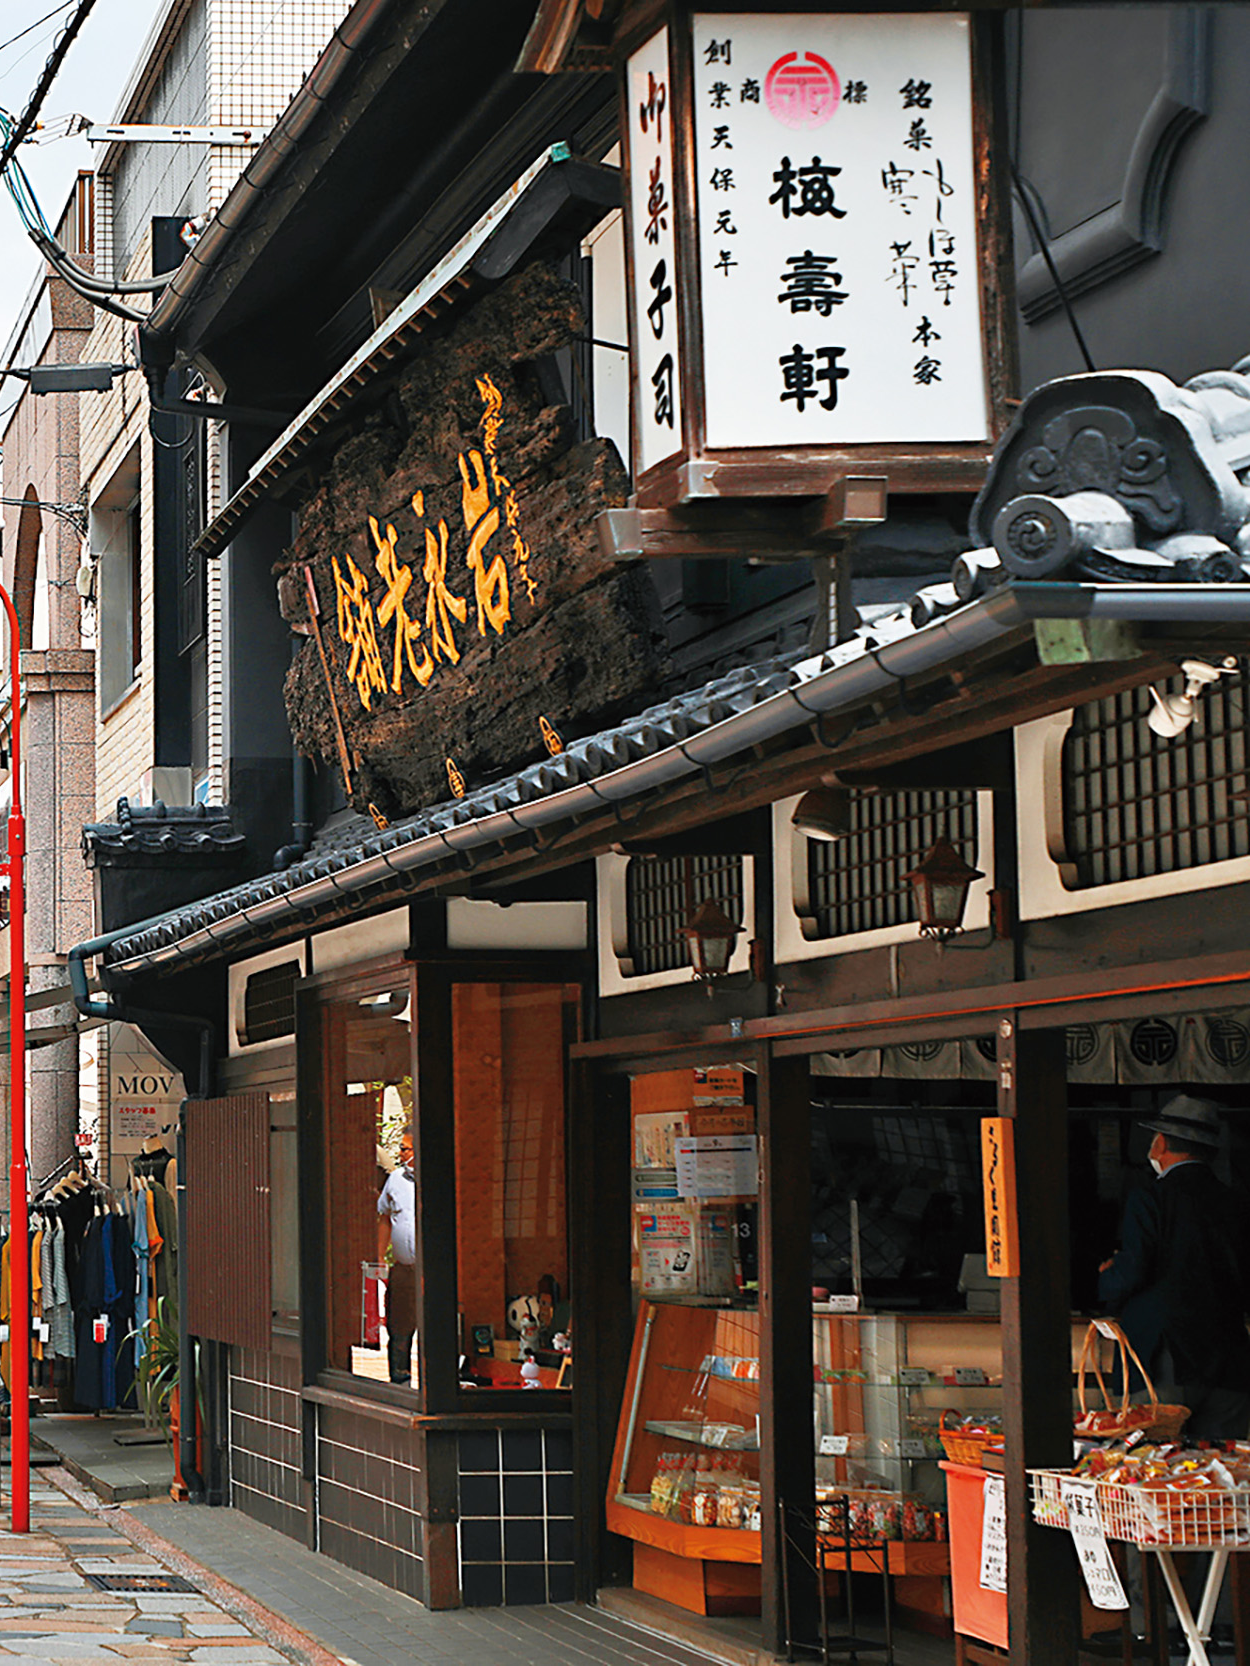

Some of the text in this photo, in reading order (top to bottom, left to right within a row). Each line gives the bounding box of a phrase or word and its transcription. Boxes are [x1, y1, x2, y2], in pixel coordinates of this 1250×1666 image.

[740, 78, 761, 105] 商
[703, 38, 739, 277] 創業天保元年
[911, 316, 943, 385] 本家
